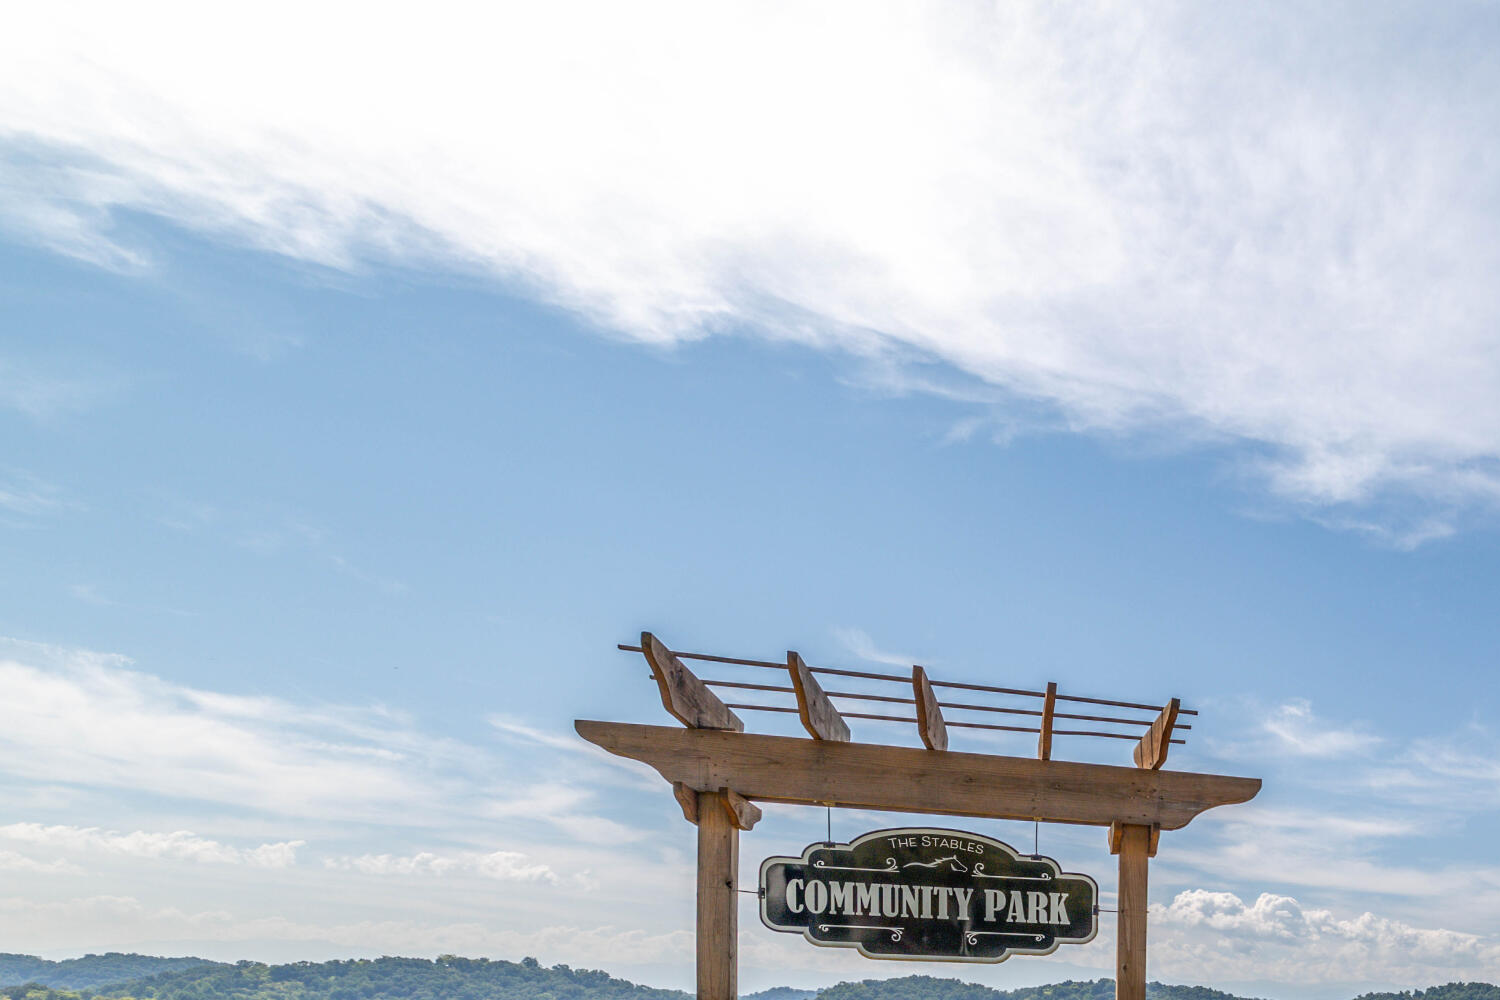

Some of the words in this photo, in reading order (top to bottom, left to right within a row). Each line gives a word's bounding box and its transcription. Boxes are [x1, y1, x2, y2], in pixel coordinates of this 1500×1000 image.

[887, 837, 918, 849] THE
[921, 835, 984, 855] STABLES
[785, 878, 974, 921] COMMUNITY
[984, 888, 1071, 925] PARK
